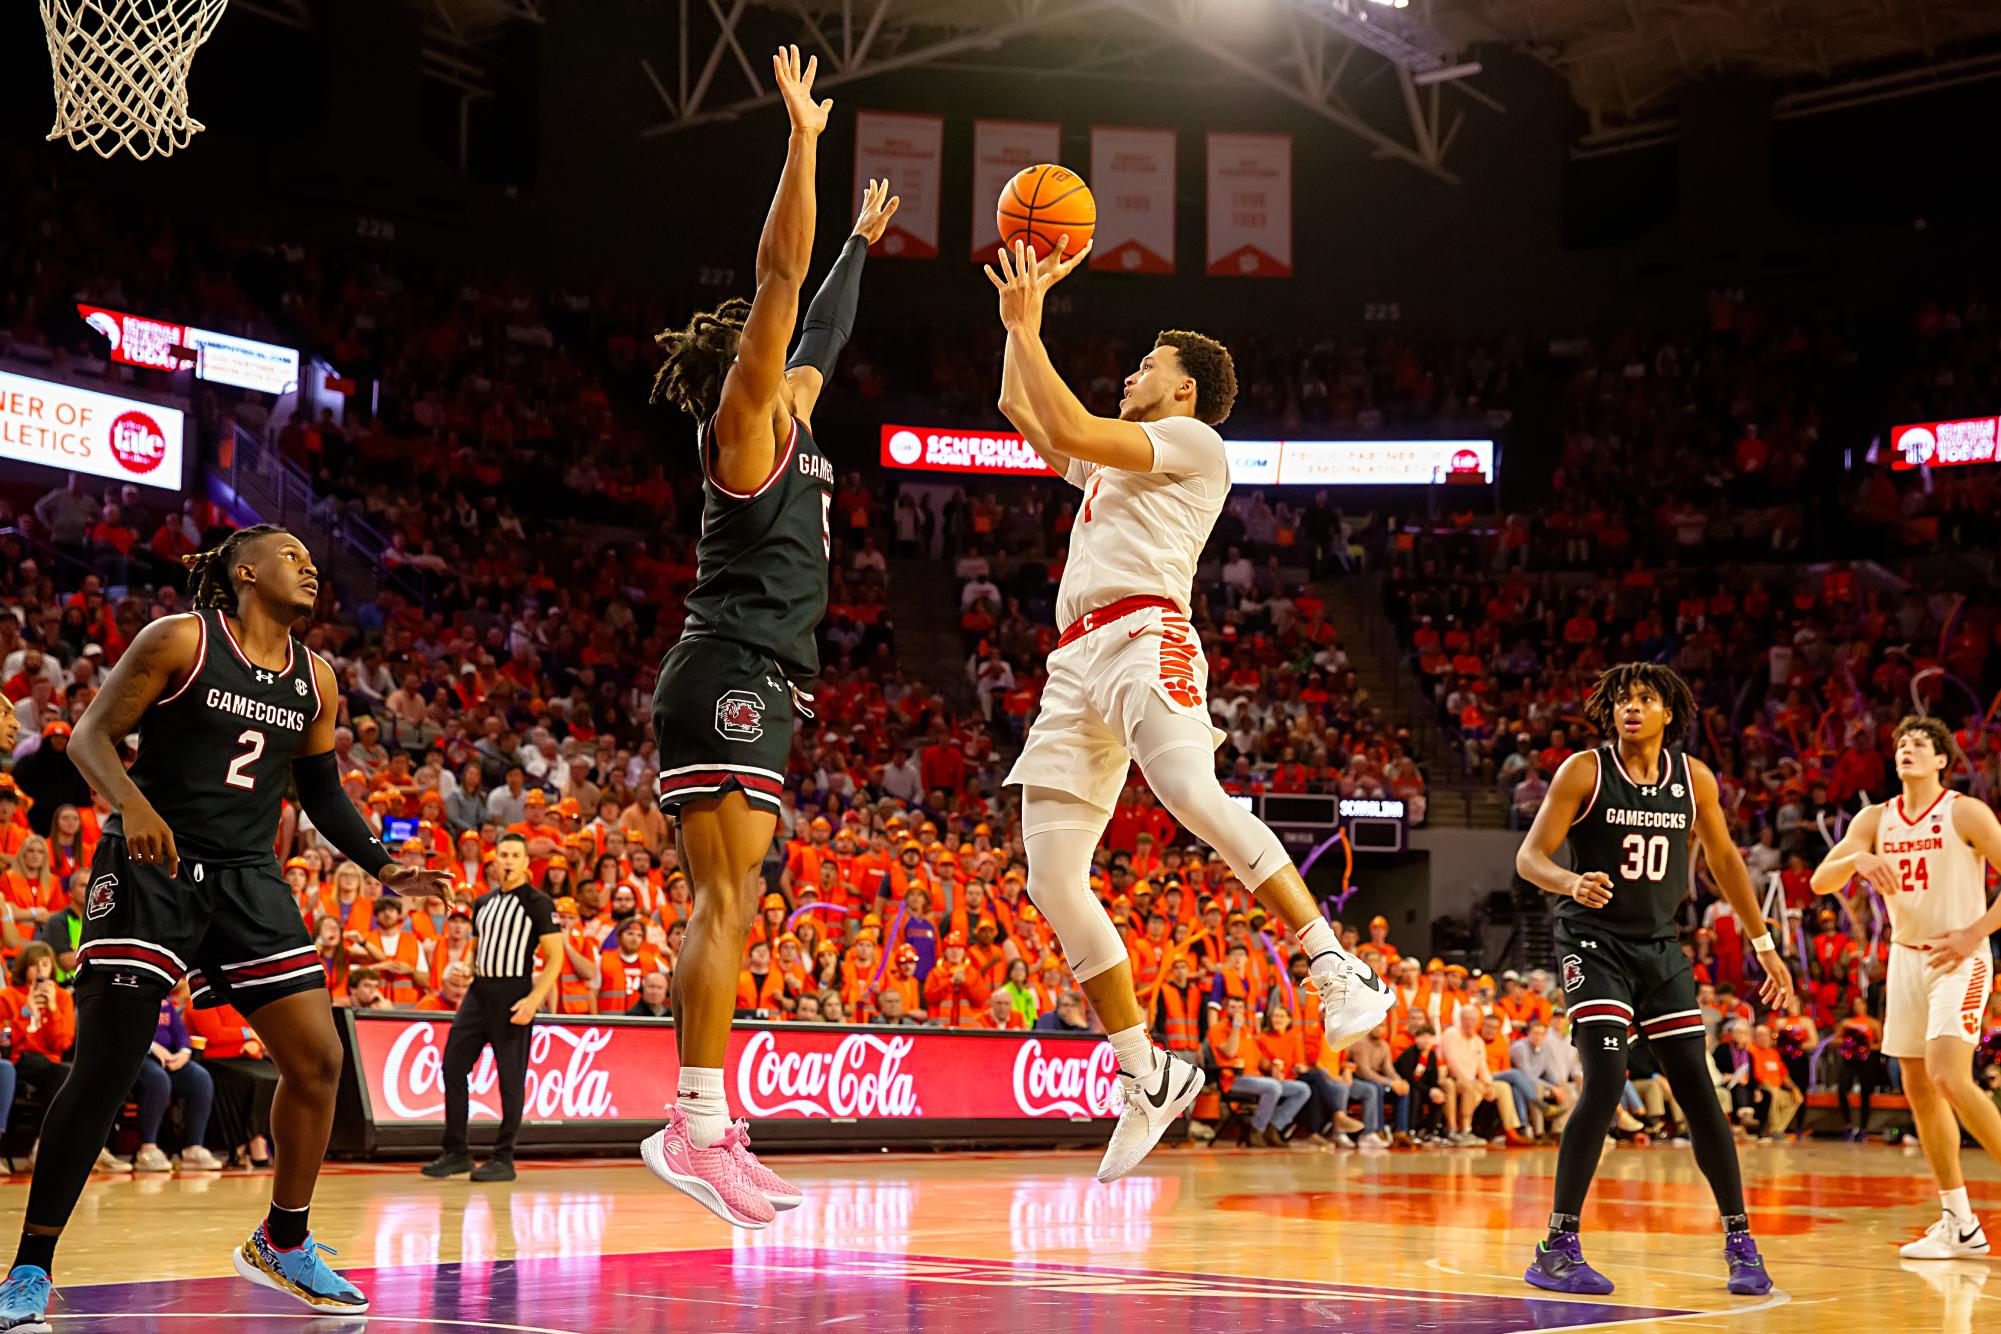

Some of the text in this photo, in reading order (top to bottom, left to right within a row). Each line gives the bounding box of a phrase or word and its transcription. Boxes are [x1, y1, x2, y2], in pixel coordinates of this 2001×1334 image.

[56, 402, 93, 427] OF
[3, 421, 91, 457] LETICS
[206, 688, 304, 731] GAMECOCKS
[225, 729, 265, 790] 2
[1605, 808, 1687, 829] GAMECOCKS
[1620, 833, 1669, 881] 30
[1883, 838, 1943, 854] CLEMSON
[1899, 857, 1928, 892] 24
[737, 1031, 917, 1117] Coca-Cola
